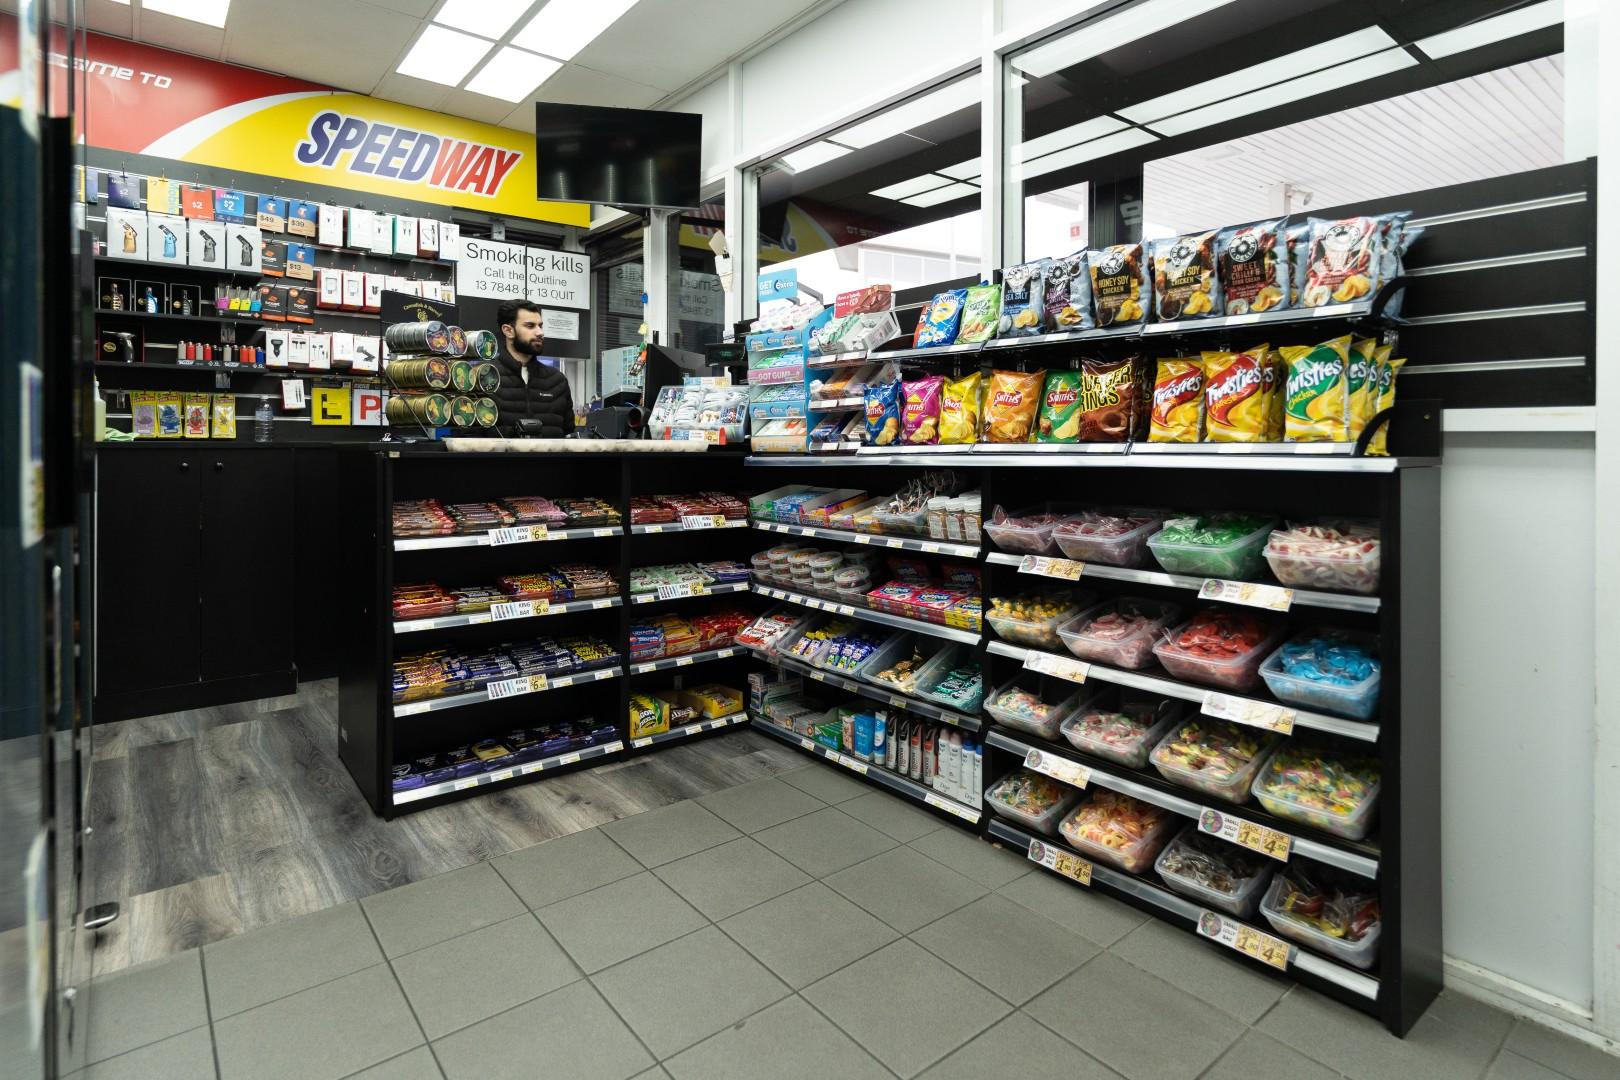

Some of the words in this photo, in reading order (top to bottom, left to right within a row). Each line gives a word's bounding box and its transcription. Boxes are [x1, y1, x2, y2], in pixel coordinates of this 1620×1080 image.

[297, 111, 522, 196] SPEEDWAY
[192, 200, 204, 210] $2
[223, 199, 235, 211] $2
[466, 242, 546, 272] Smoking
[551, 254, 584, 274] kills
[1187, 265, 1201, 276] SOY
[1232, 261, 1257, 273] SWEET
[484, 266, 505, 279] Call
[508, 269, 525, 281] the
[529, 273, 568, 287] Quitline
[1117, 275, 1130, 286] SOY
[1171, 276, 1195, 287] CHICKEN
[475, 280, 487, 291] 13
[490, 281, 519, 294] 7848
[521, 287, 534, 296] or
[538, 288, 548, 298] 13
[759, 281, 773, 290] GET
[1102, 286, 1125, 295] CHICKEN
[1081, 364, 1132, 394] URGER
[1205, 366, 1262, 406] Twisties
[360, 394, 382, 420] P
